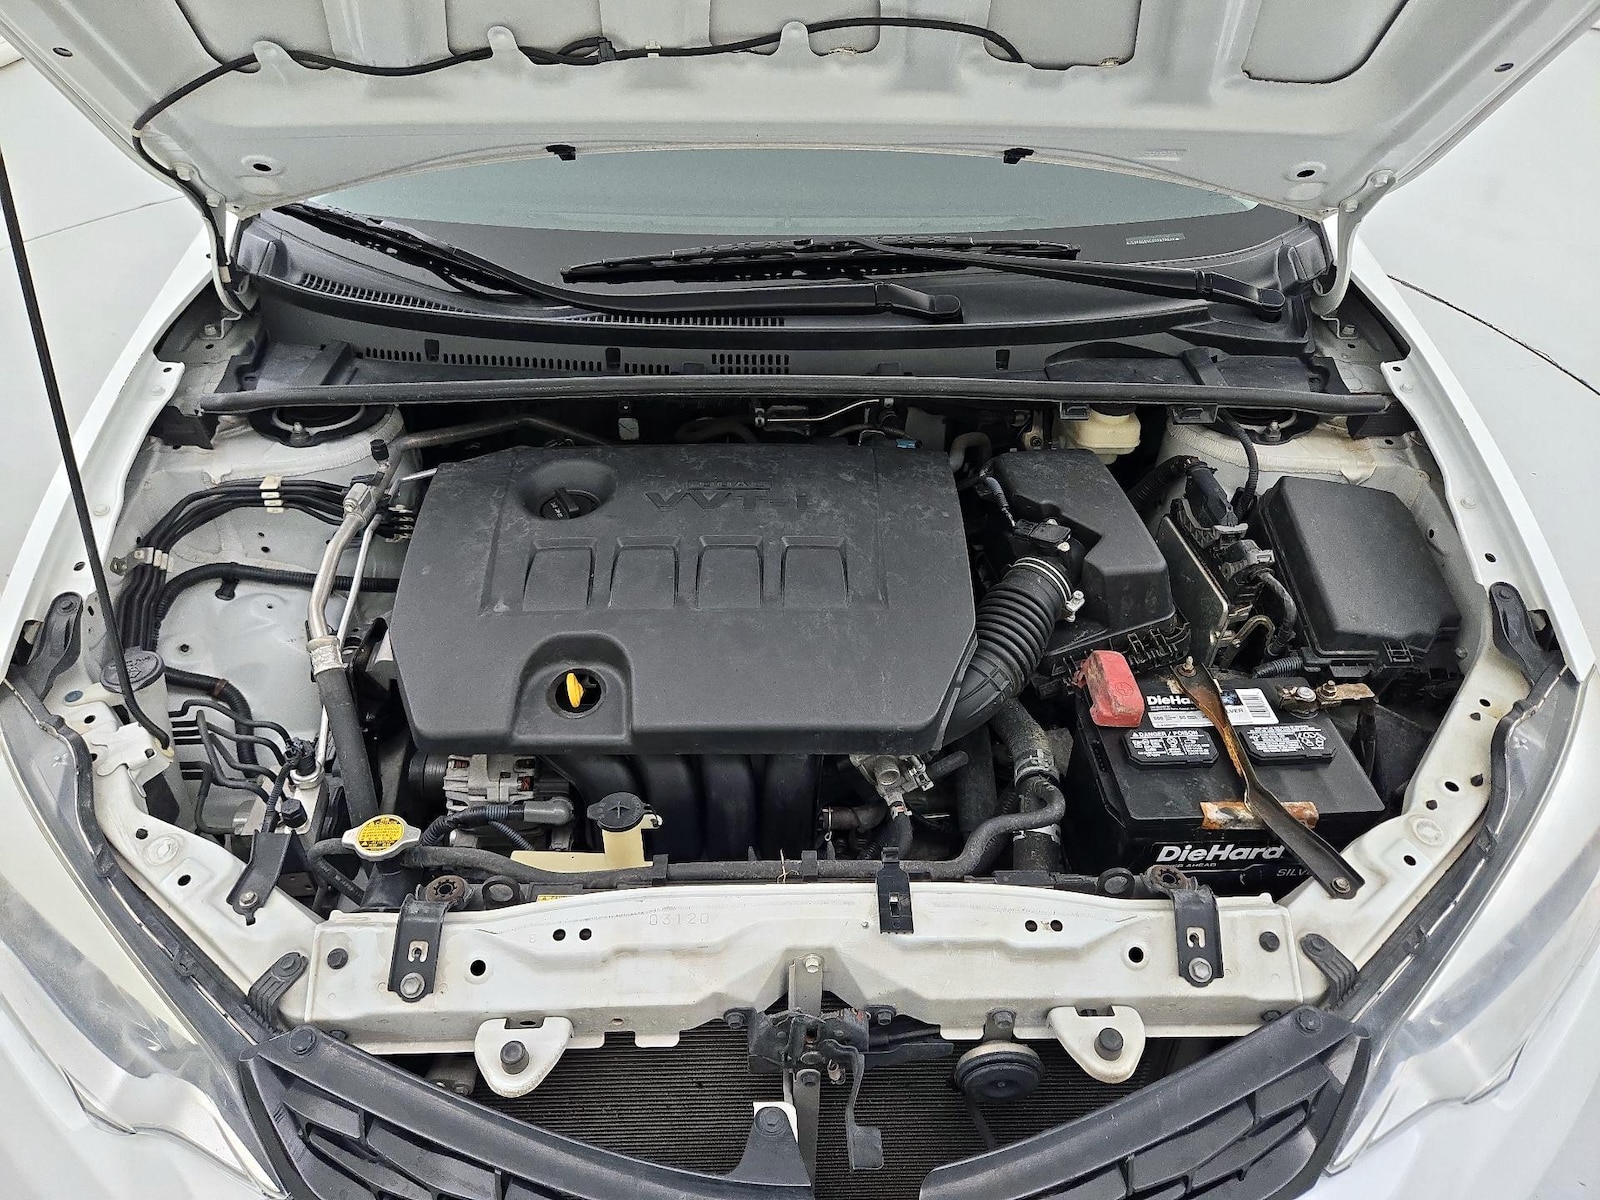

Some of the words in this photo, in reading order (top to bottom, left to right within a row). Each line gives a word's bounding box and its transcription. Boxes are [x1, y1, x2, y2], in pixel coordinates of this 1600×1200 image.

[1146, 694, 1194, 705] DieHa
[1156, 844, 1286, 862] DieHard
[1276, 868, 1311, 877] SILV
[649, 912, 710, 926] 03120
